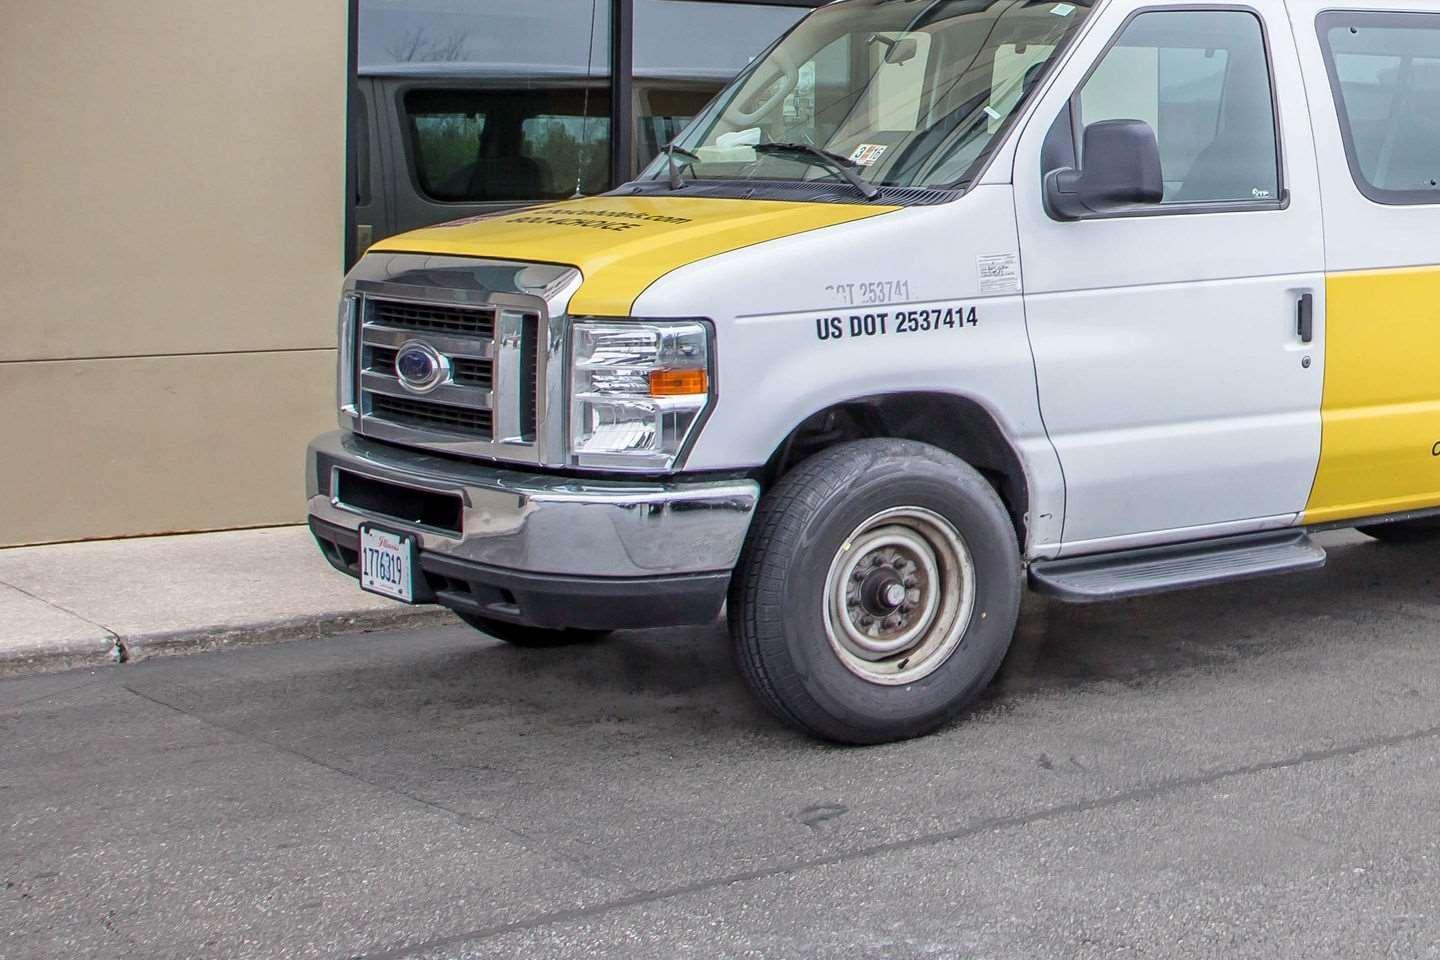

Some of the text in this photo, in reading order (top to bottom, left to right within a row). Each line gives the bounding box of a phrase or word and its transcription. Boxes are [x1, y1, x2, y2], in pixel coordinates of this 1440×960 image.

[816, 306, 978, 340] US DOT 2537414
[363, 547, 403, 586] 1776319
